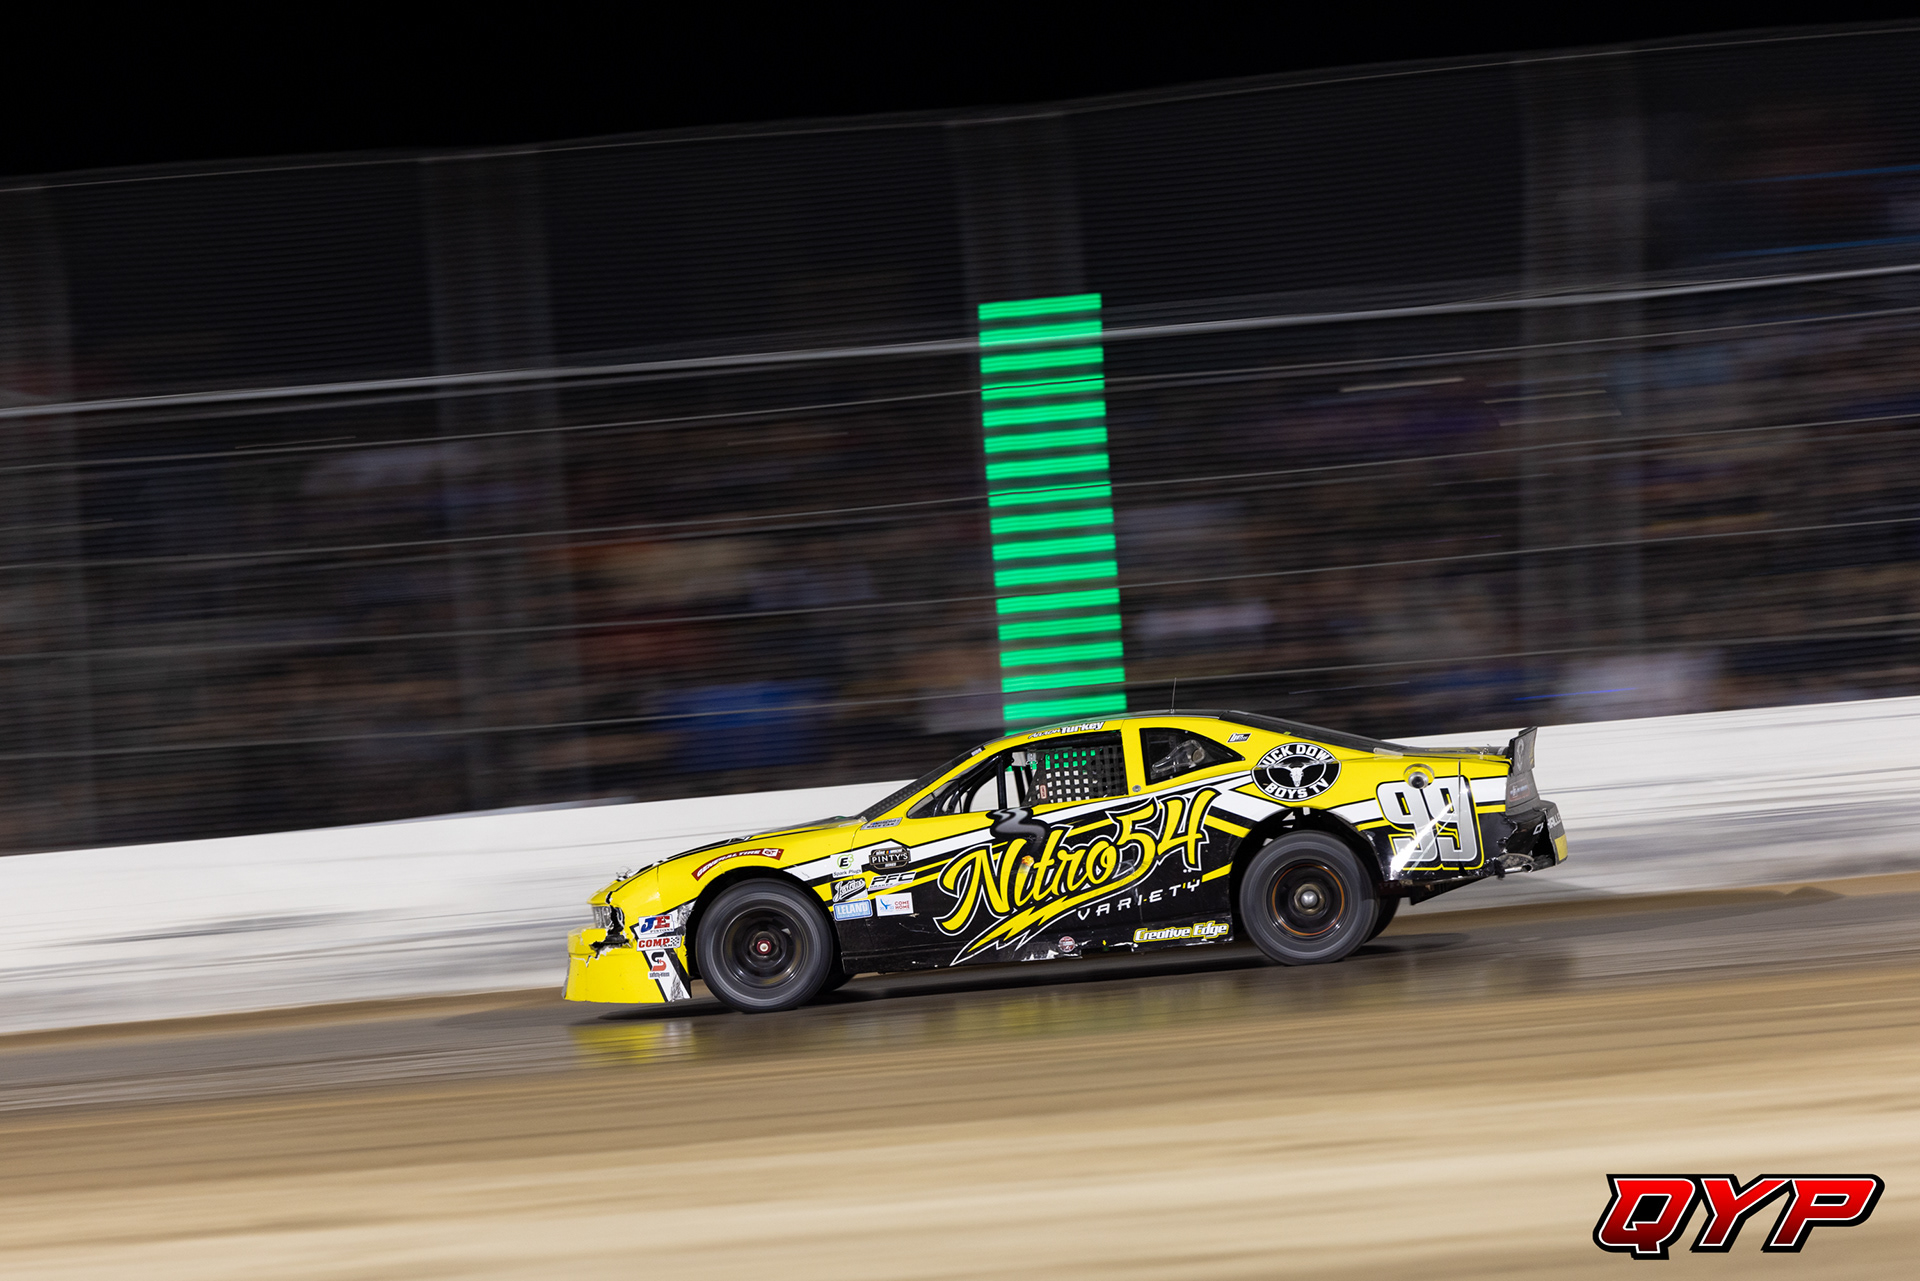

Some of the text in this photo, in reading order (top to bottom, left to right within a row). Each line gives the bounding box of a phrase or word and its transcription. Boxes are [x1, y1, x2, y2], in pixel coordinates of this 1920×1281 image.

[1060, 721, 1105, 734] Turkey
[1256, 744, 1336, 768] UCK DOW
[1264, 777, 1329, 799] BOYS TV
[1375, 776, 1480, 866] 99
[872, 853, 908, 864] PINTY'S
[871, 871, 916, 885] PFC
[837, 902, 868, 915] LELAND
[1077, 879, 1201, 921] VARIETY
[640, 915, 671, 934] JE
[1133, 921, 1229, 943] Creative Edge
[638, 937, 670, 949] COMP
